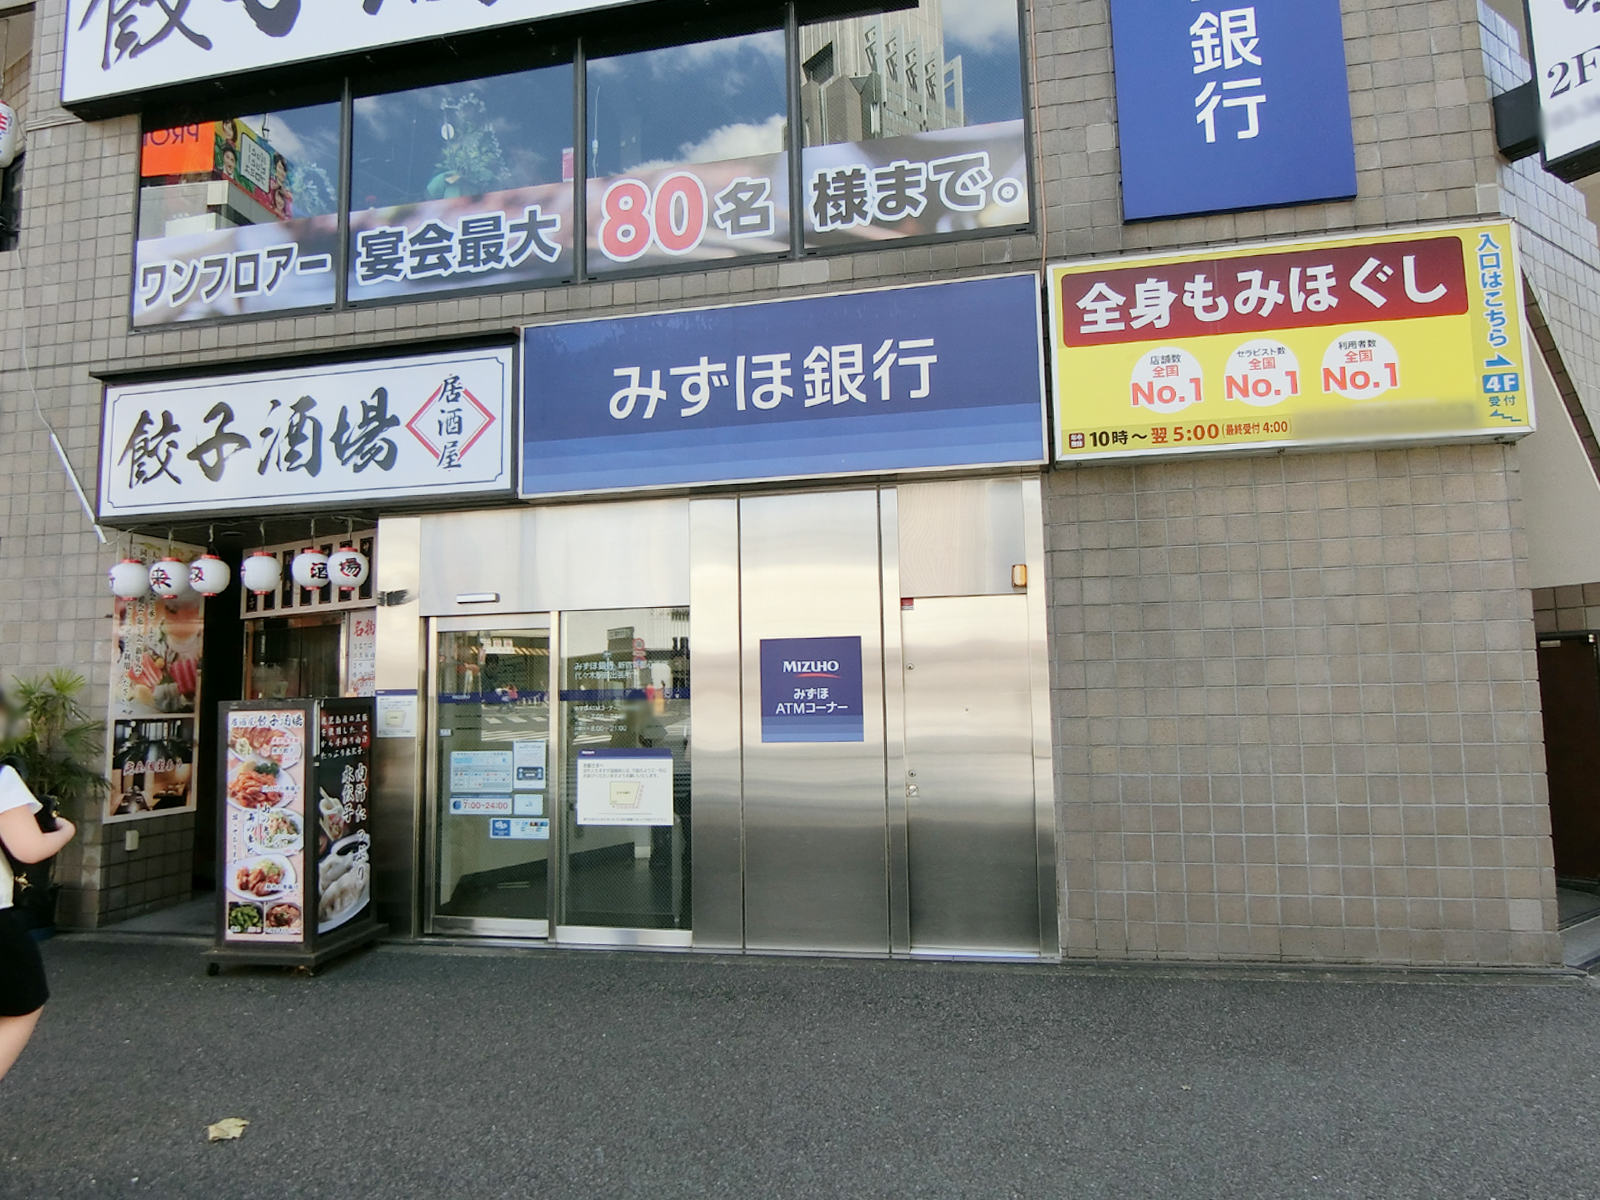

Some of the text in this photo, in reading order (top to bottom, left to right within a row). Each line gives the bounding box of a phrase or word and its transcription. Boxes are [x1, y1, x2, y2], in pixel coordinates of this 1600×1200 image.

[1189, 6, 1267, 143] 銀行
[1547, 46, 1600, 98] 2F
[139, 242, 332, 309] ワンフロアー
[358, 206, 561, 285] 宴会最大
[810, 153, 1023, 232] 様まで。
[1075, 255, 1448, 334] 全身もみほぐし
[1478, 233, 1508, 346] 入口はこちら
[1236, 346, 1286, 358] セラピスト数
[1338, 338, 1378, 350] 利用者数
[1150, 353, 1182, 366] 店舗数
[1248, 356, 1276, 371] 全国
[1344, 349, 1373, 364] 全国
[609, 338, 938, 419] みずほ銀行
[1152, 364, 1179, 379] 全国
[1322, 362, 1399, 392] No.1
[1131, 377, 1203, 406] No.1
[1225, 370, 1299, 400] No.1
[1486, 375, 1516, 392] 4F
[1488, 395, 1516, 407] 受付
[437, 374, 465, 470] 居酒屋
[117, 387, 401, 489] 餃子酒場
[783, 660, 840, 673] MIZUHO
[793, 687, 830, 700] みずほ
[775, 701, 849, 714] ATMコーナー
